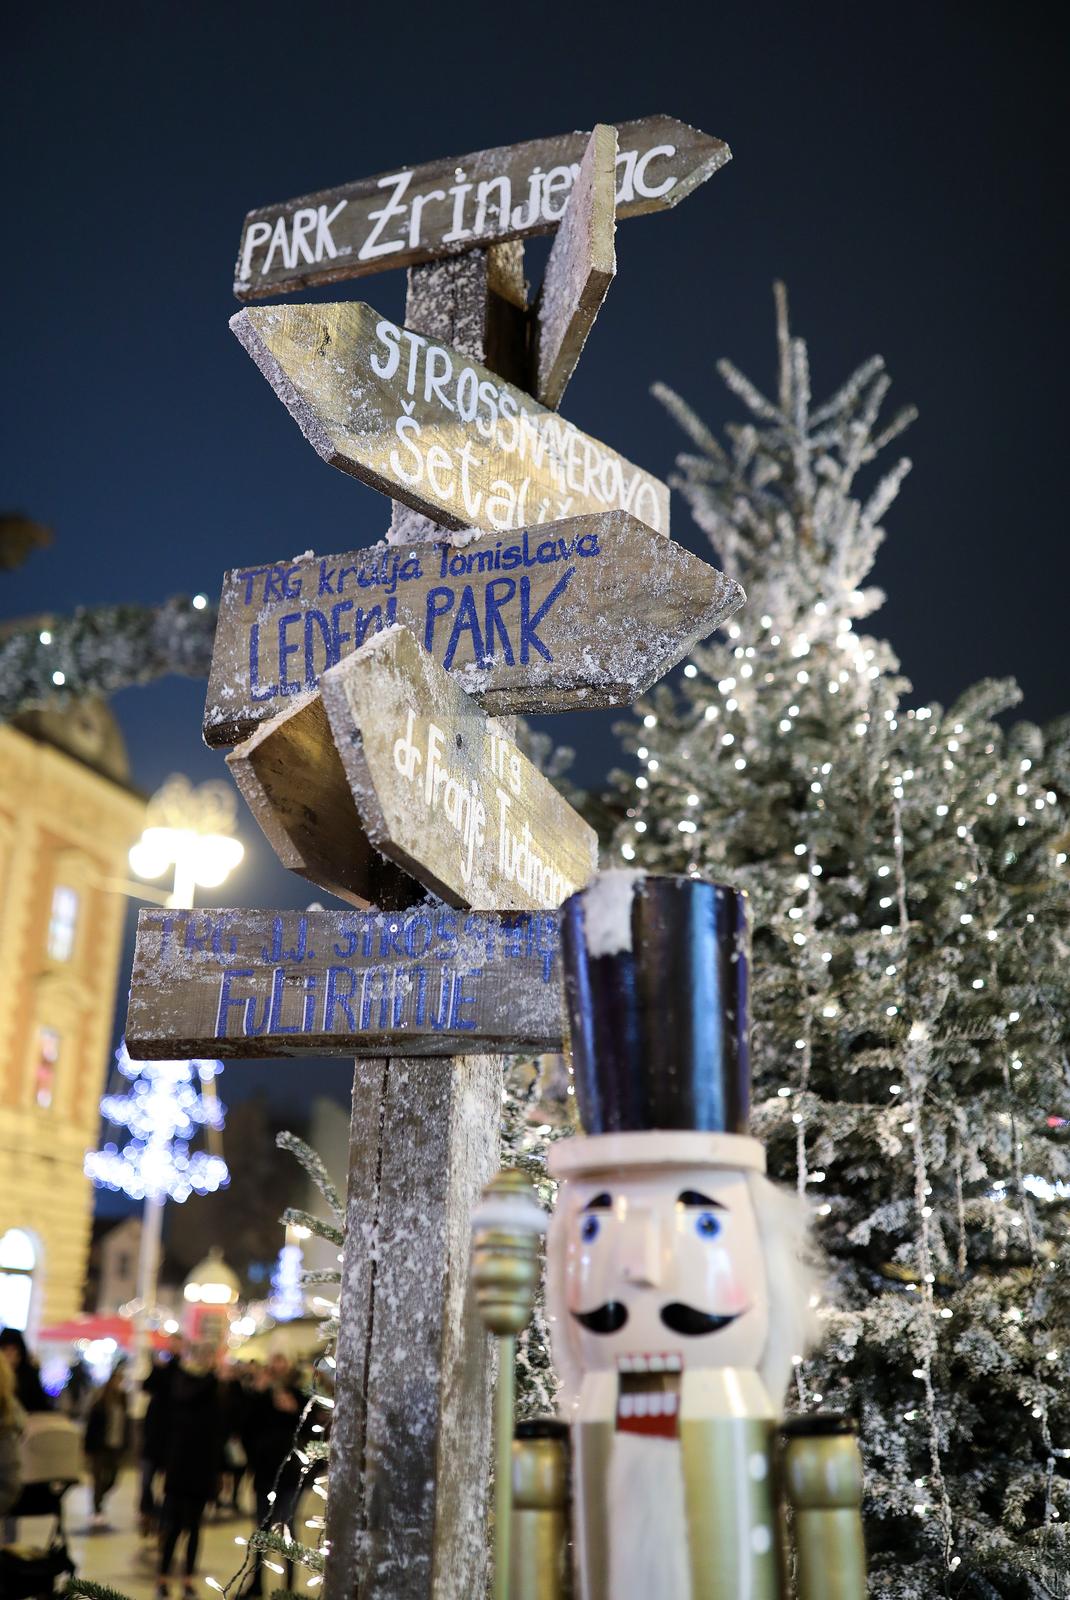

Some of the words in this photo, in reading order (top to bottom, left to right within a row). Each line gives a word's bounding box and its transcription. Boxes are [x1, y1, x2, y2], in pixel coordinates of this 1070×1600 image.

[240, 200, 348, 280] PARK
[358, 144, 678, 260] Zrinjeac
[238, 566, 301, 606] TRG
[318, 549, 423, 597] kralja
[434, 531, 600, 577] Tomislava
[425, 568, 576, 670] PARK
